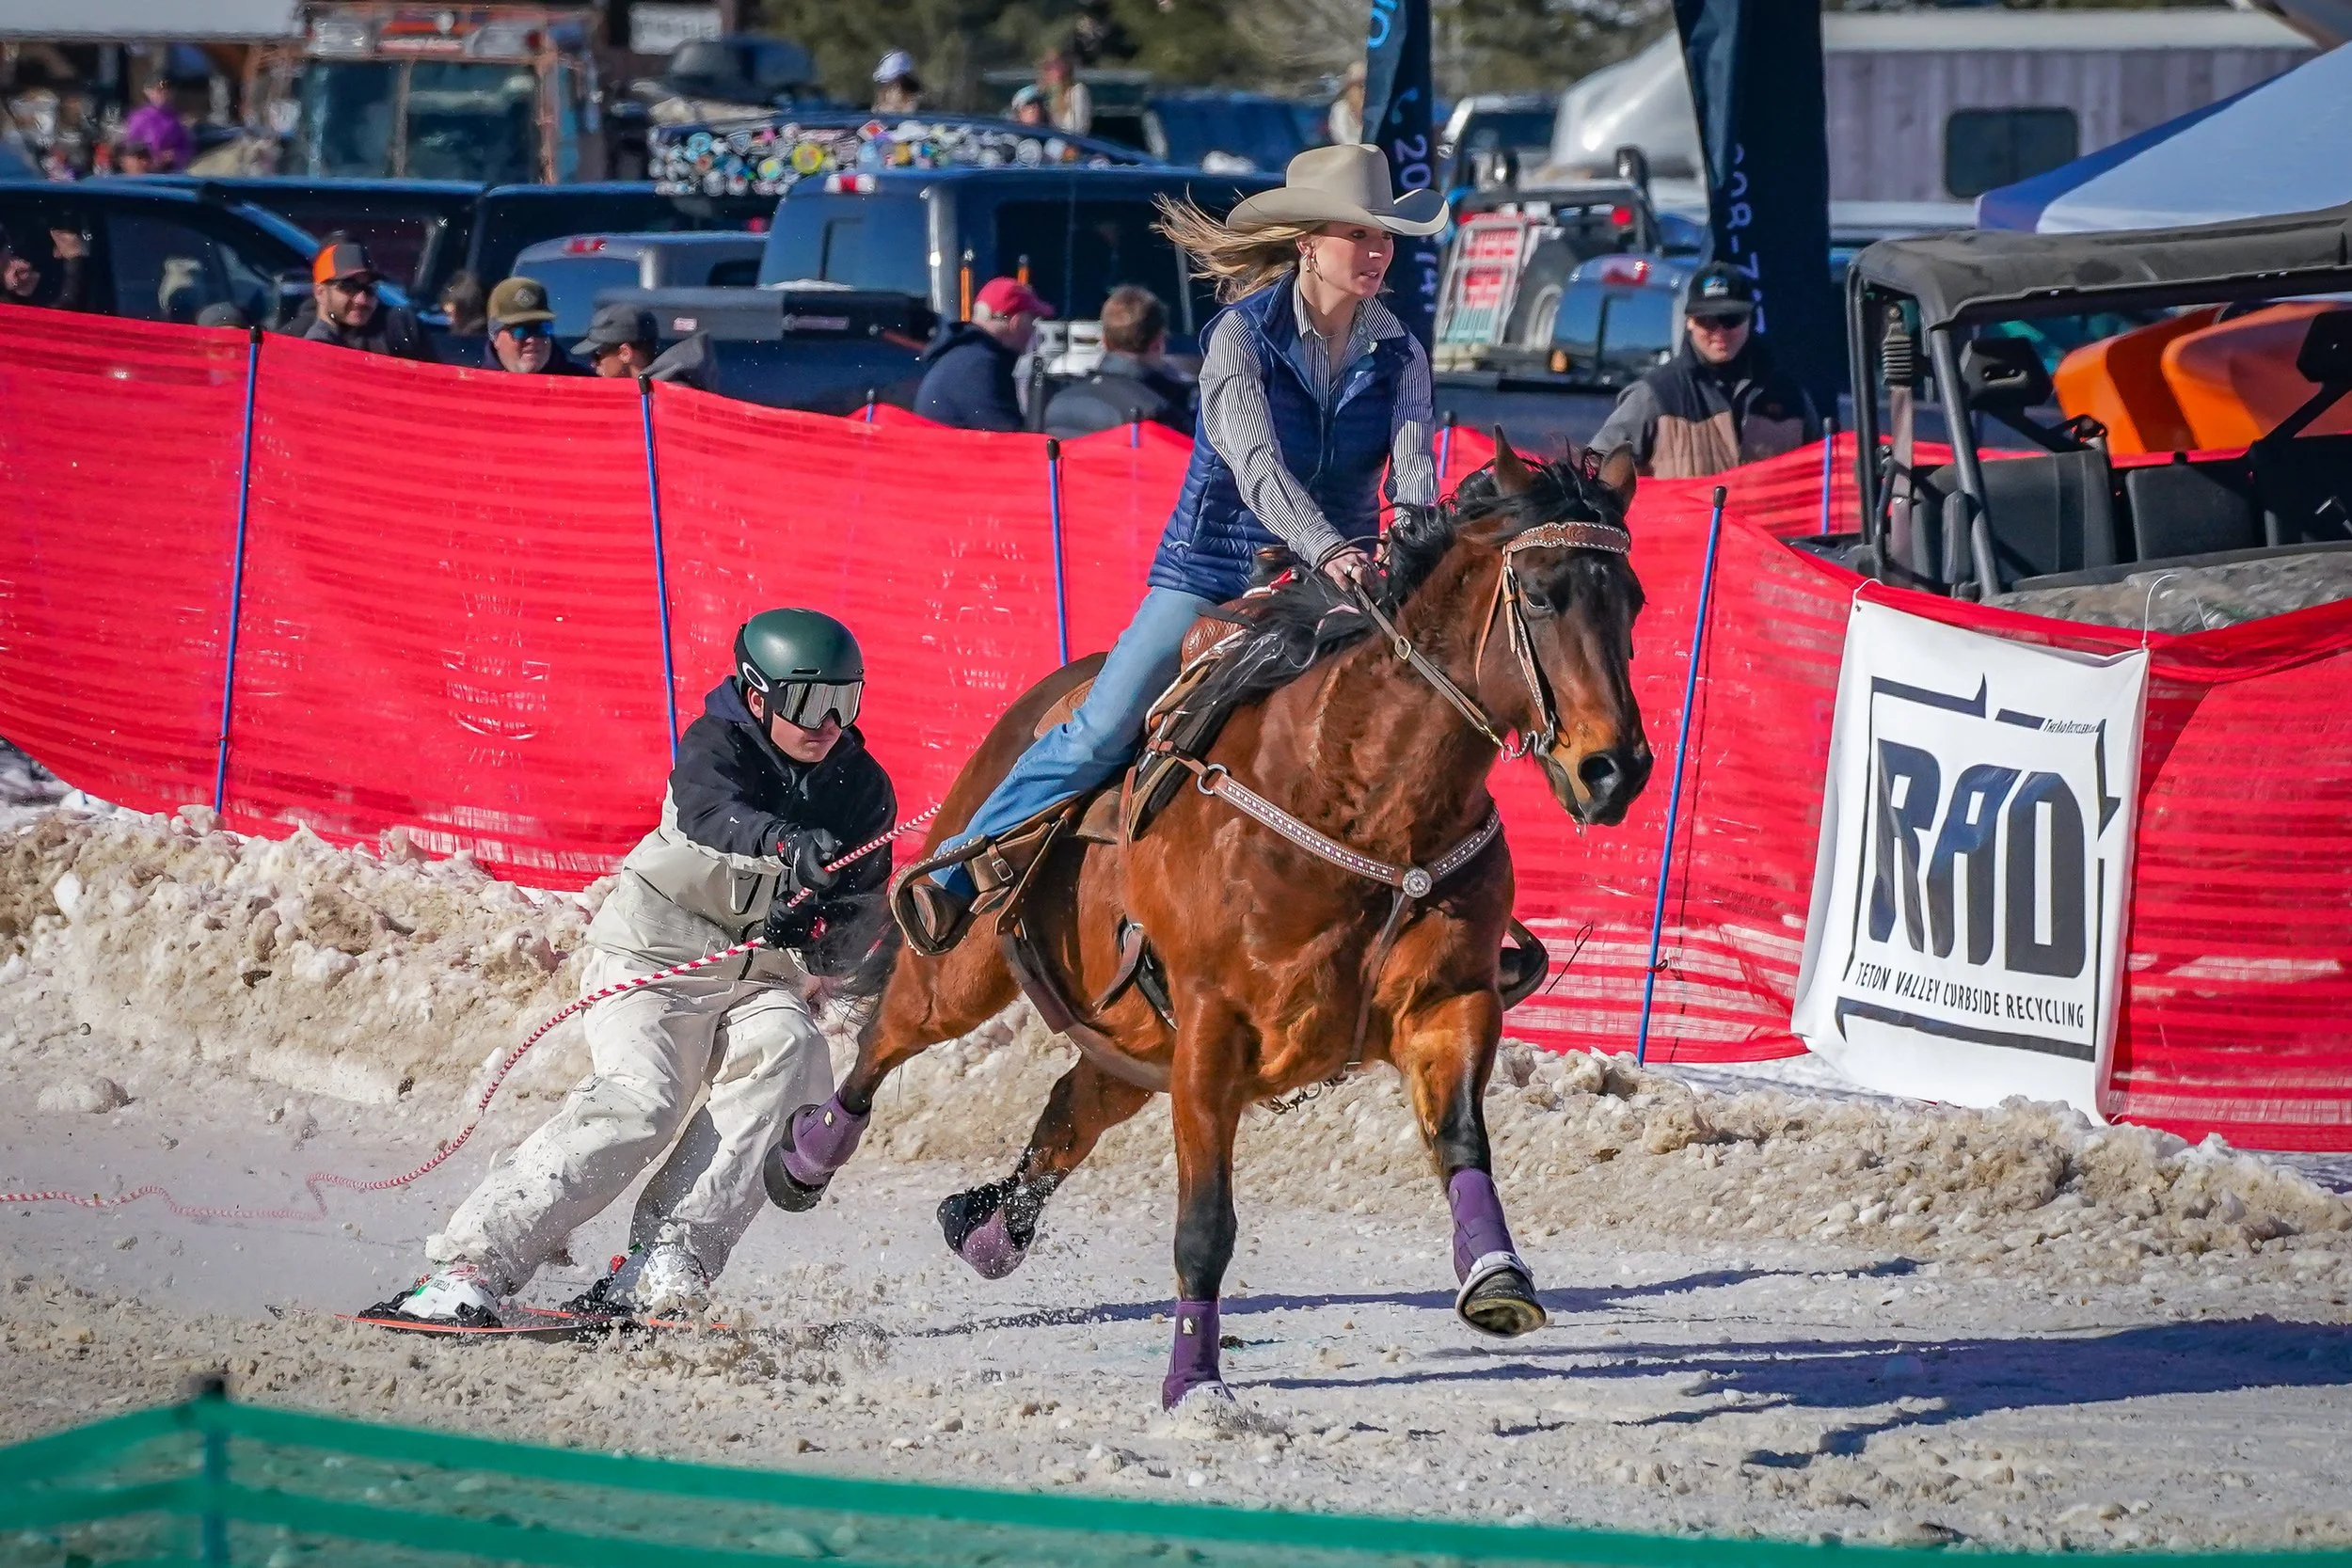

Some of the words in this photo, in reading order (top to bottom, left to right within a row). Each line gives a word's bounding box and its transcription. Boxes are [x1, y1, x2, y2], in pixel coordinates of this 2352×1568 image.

[1868, 737, 2087, 979] RAD
[1855, 962, 1891, 991] TETON
[1895, 971, 1941, 1004] VALLEY
[1943, 982, 2000, 1016] CURBSIDE
[2006, 993, 2084, 1028] RECYCLING
